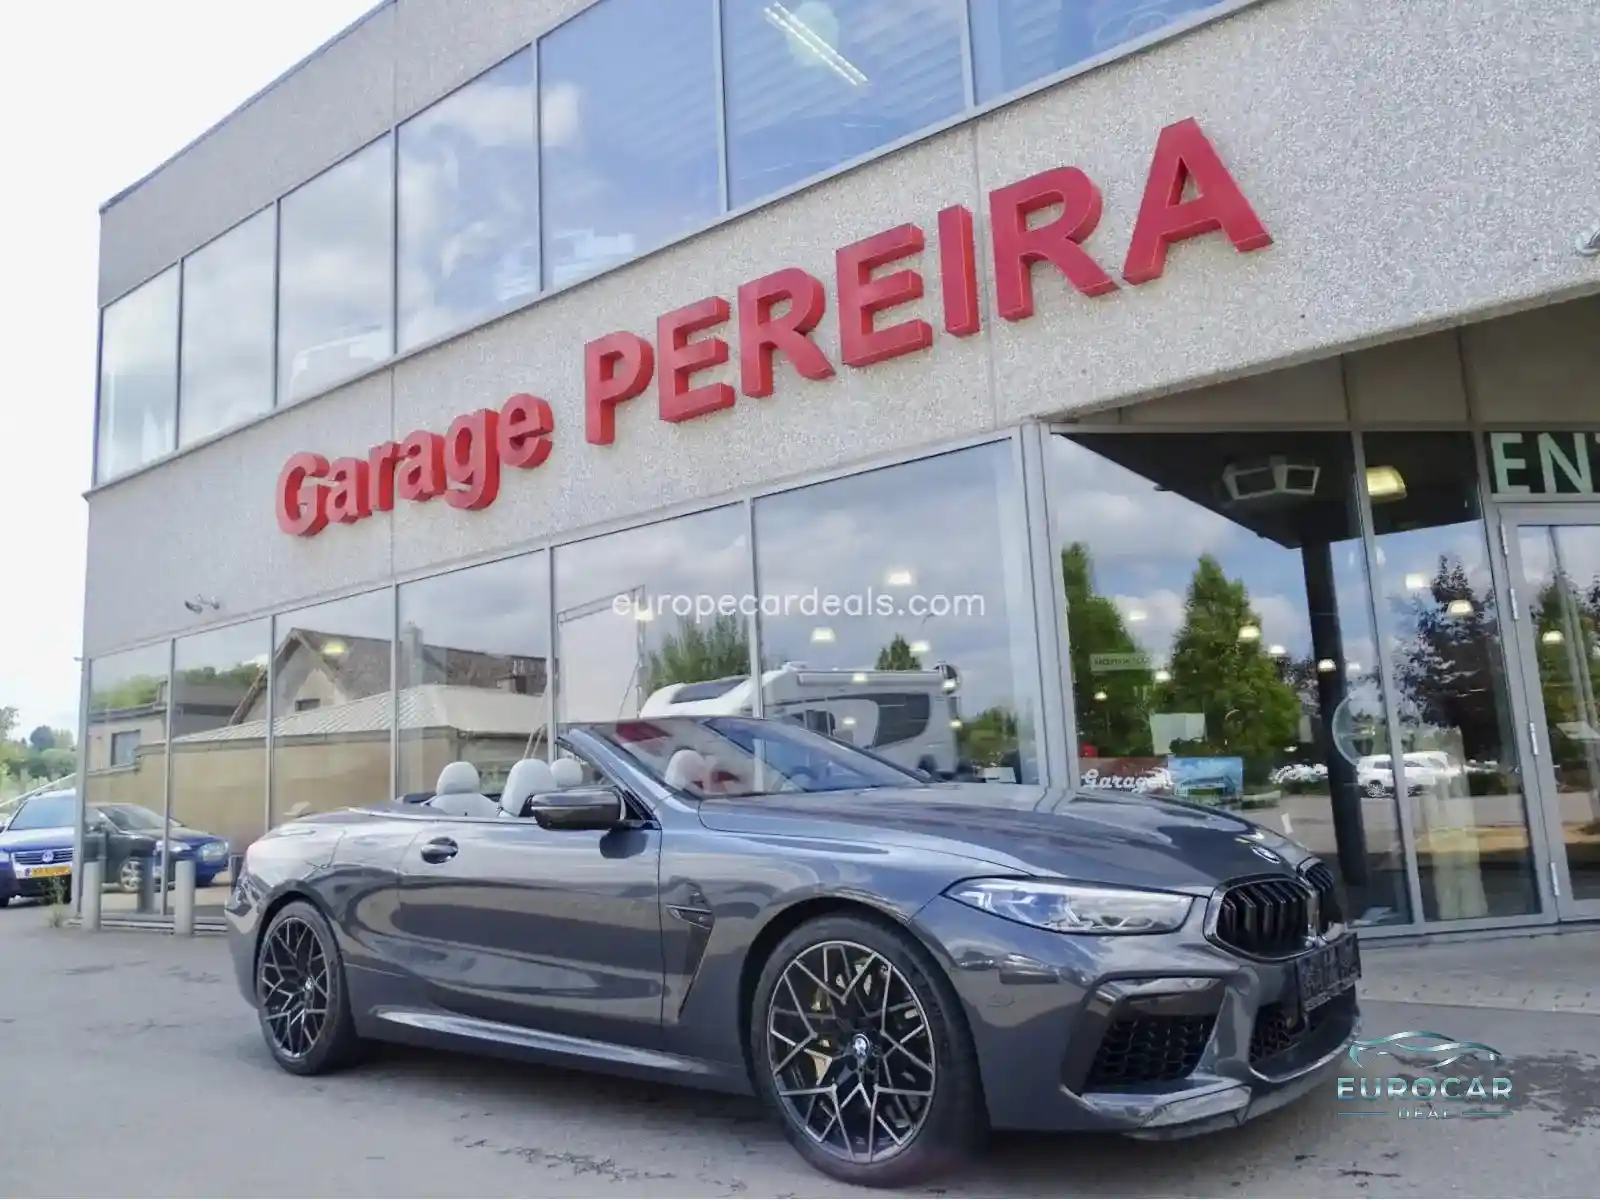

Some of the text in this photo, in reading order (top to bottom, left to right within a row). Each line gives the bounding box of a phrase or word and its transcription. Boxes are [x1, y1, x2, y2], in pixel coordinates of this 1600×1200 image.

[275, 117, 1274, 537] Garage PEREIRA
[1490, 432, 1600, 495] EN
[1081, 768, 1157, 793] Garag
